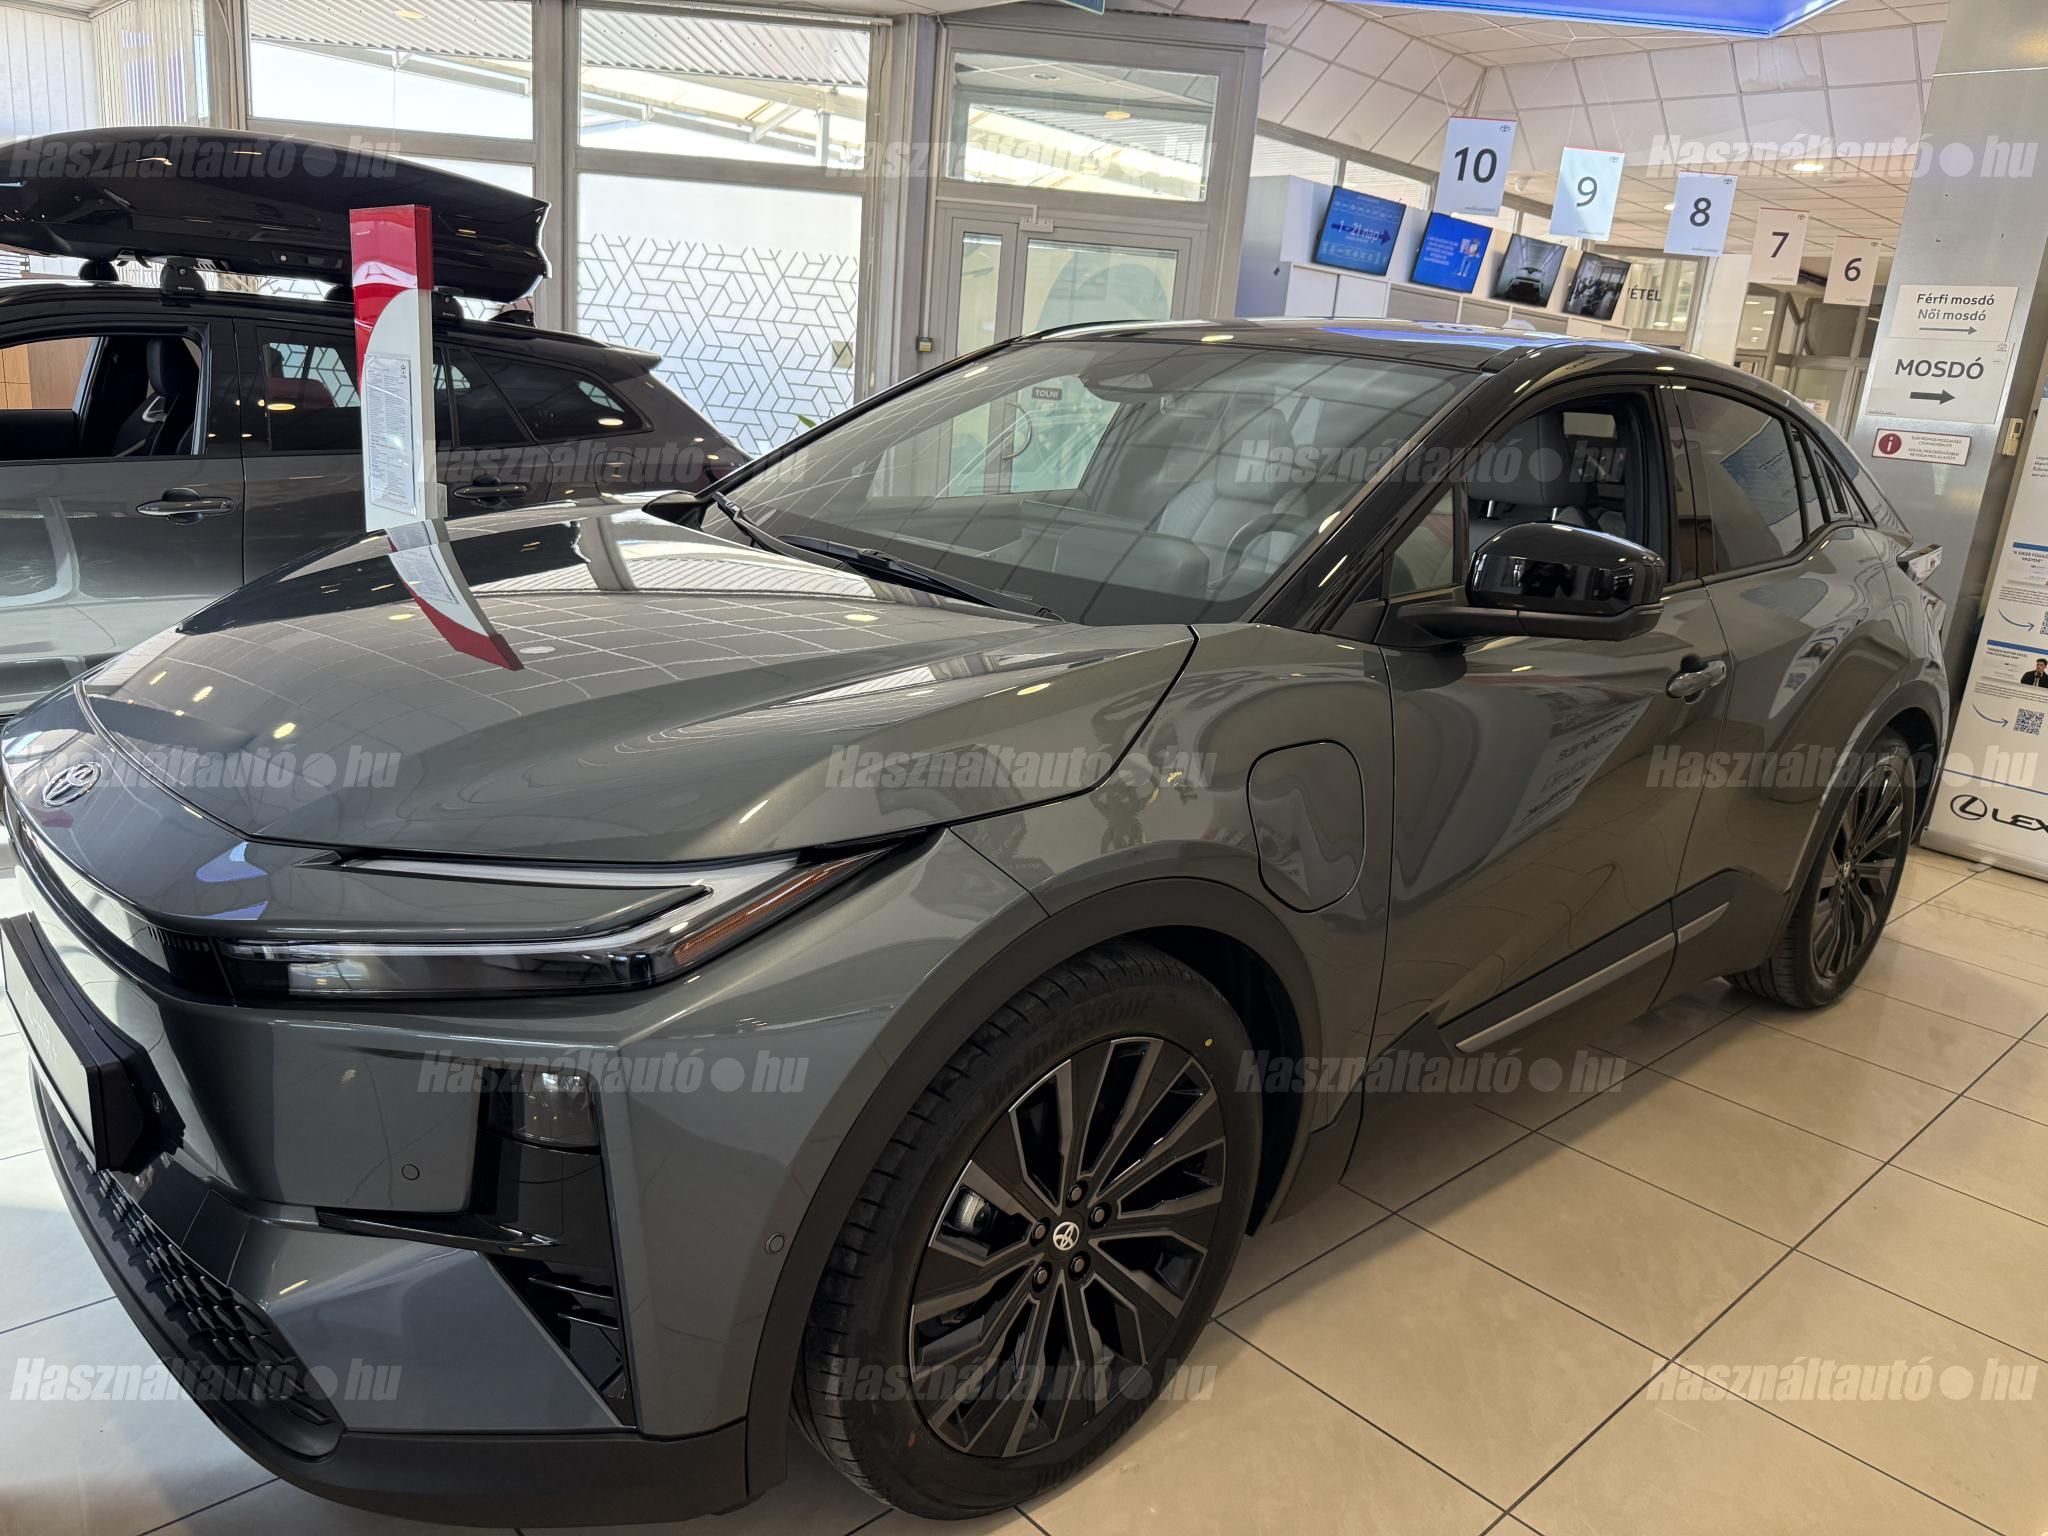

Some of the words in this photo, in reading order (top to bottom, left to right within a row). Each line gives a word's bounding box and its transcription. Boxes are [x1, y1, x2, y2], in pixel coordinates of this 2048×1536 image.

[1454, 147, 1497, 184] 10
[1576, 176, 1598, 207] 9
[1689, 197, 1712, 227] 8
[1770, 231, 1790, 258] 7
[1844, 257, 1863, 282] 6
[1628, 285, 1662, 302] ÉTEL
[1917, 292, 1948, 305] Férfi
[1950, 294, 1995, 306] mosdó
[1918, 308, 1940, 320] Női
[1942, 310, 1987, 321] mosdó
[1894, 357, 1985, 380] MOSDÓ
[1035, 389, 1059, 398] TOLNI
